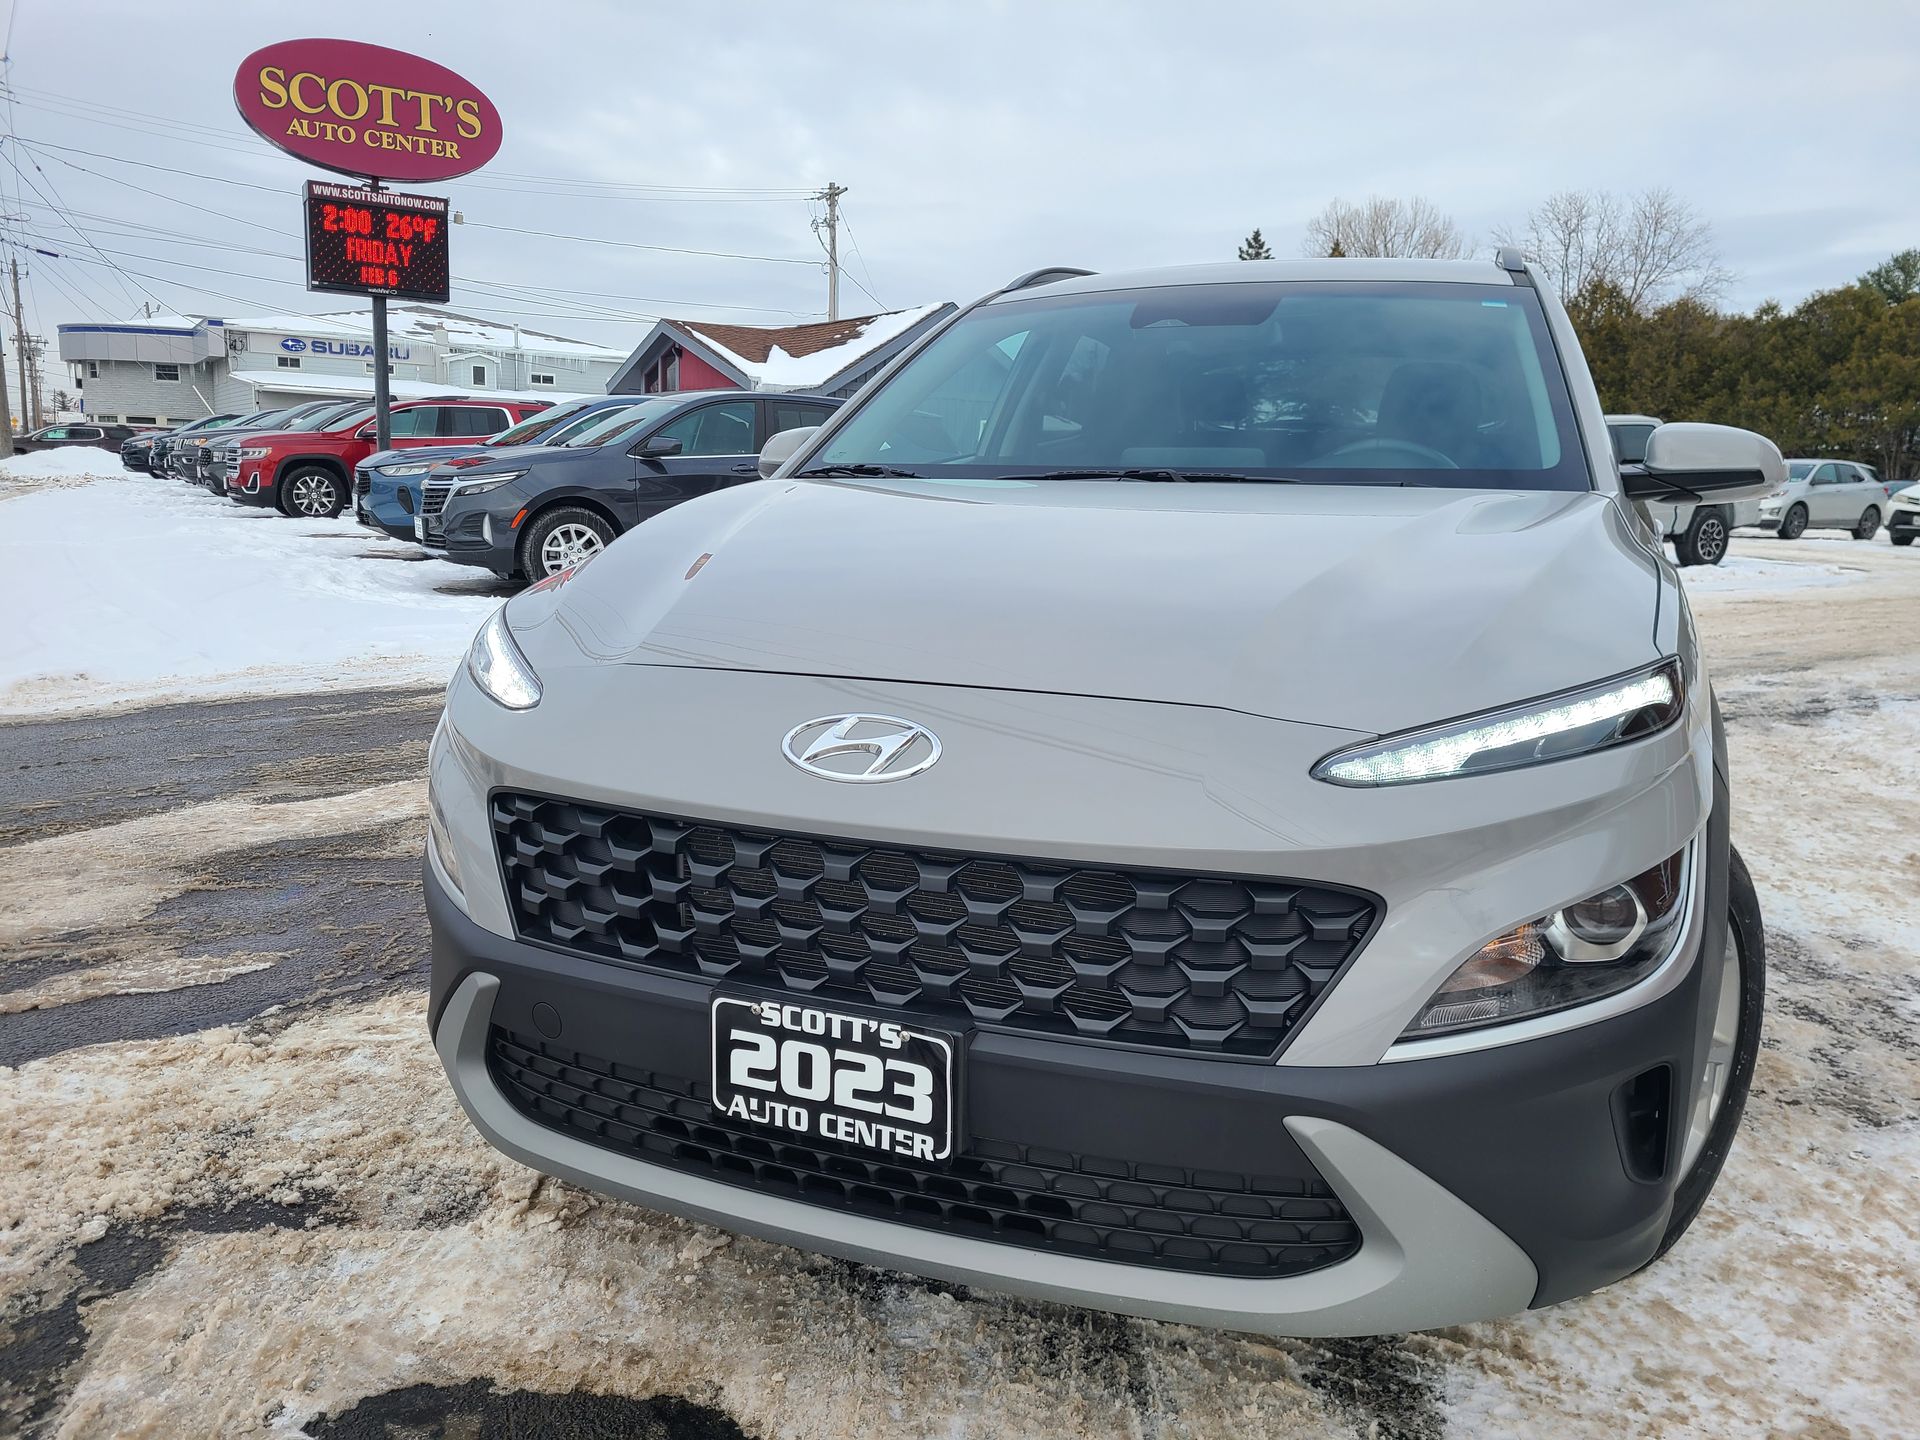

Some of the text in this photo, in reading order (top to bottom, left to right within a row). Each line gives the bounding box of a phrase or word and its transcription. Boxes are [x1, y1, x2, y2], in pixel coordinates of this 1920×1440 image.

[258, 66, 483, 139] SCOTT'S
[286, 117, 461, 160] AUTO CENTER
[312, 184, 445, 212] WWW.SCOTTSAUTONOW.COM
[322, 203, 373, 235] 2:00
[345, 236, 413, 267] FRIDAY
[360, 265, 398, 286] FEB 6
[310, 340, 410, 361] SUBAU
[760, 1001, 902, 1050] SCOTT'S
[729, 1028, 934, 1125] 2023
[726, 1093, 935, 1162] AUTO CENTER
